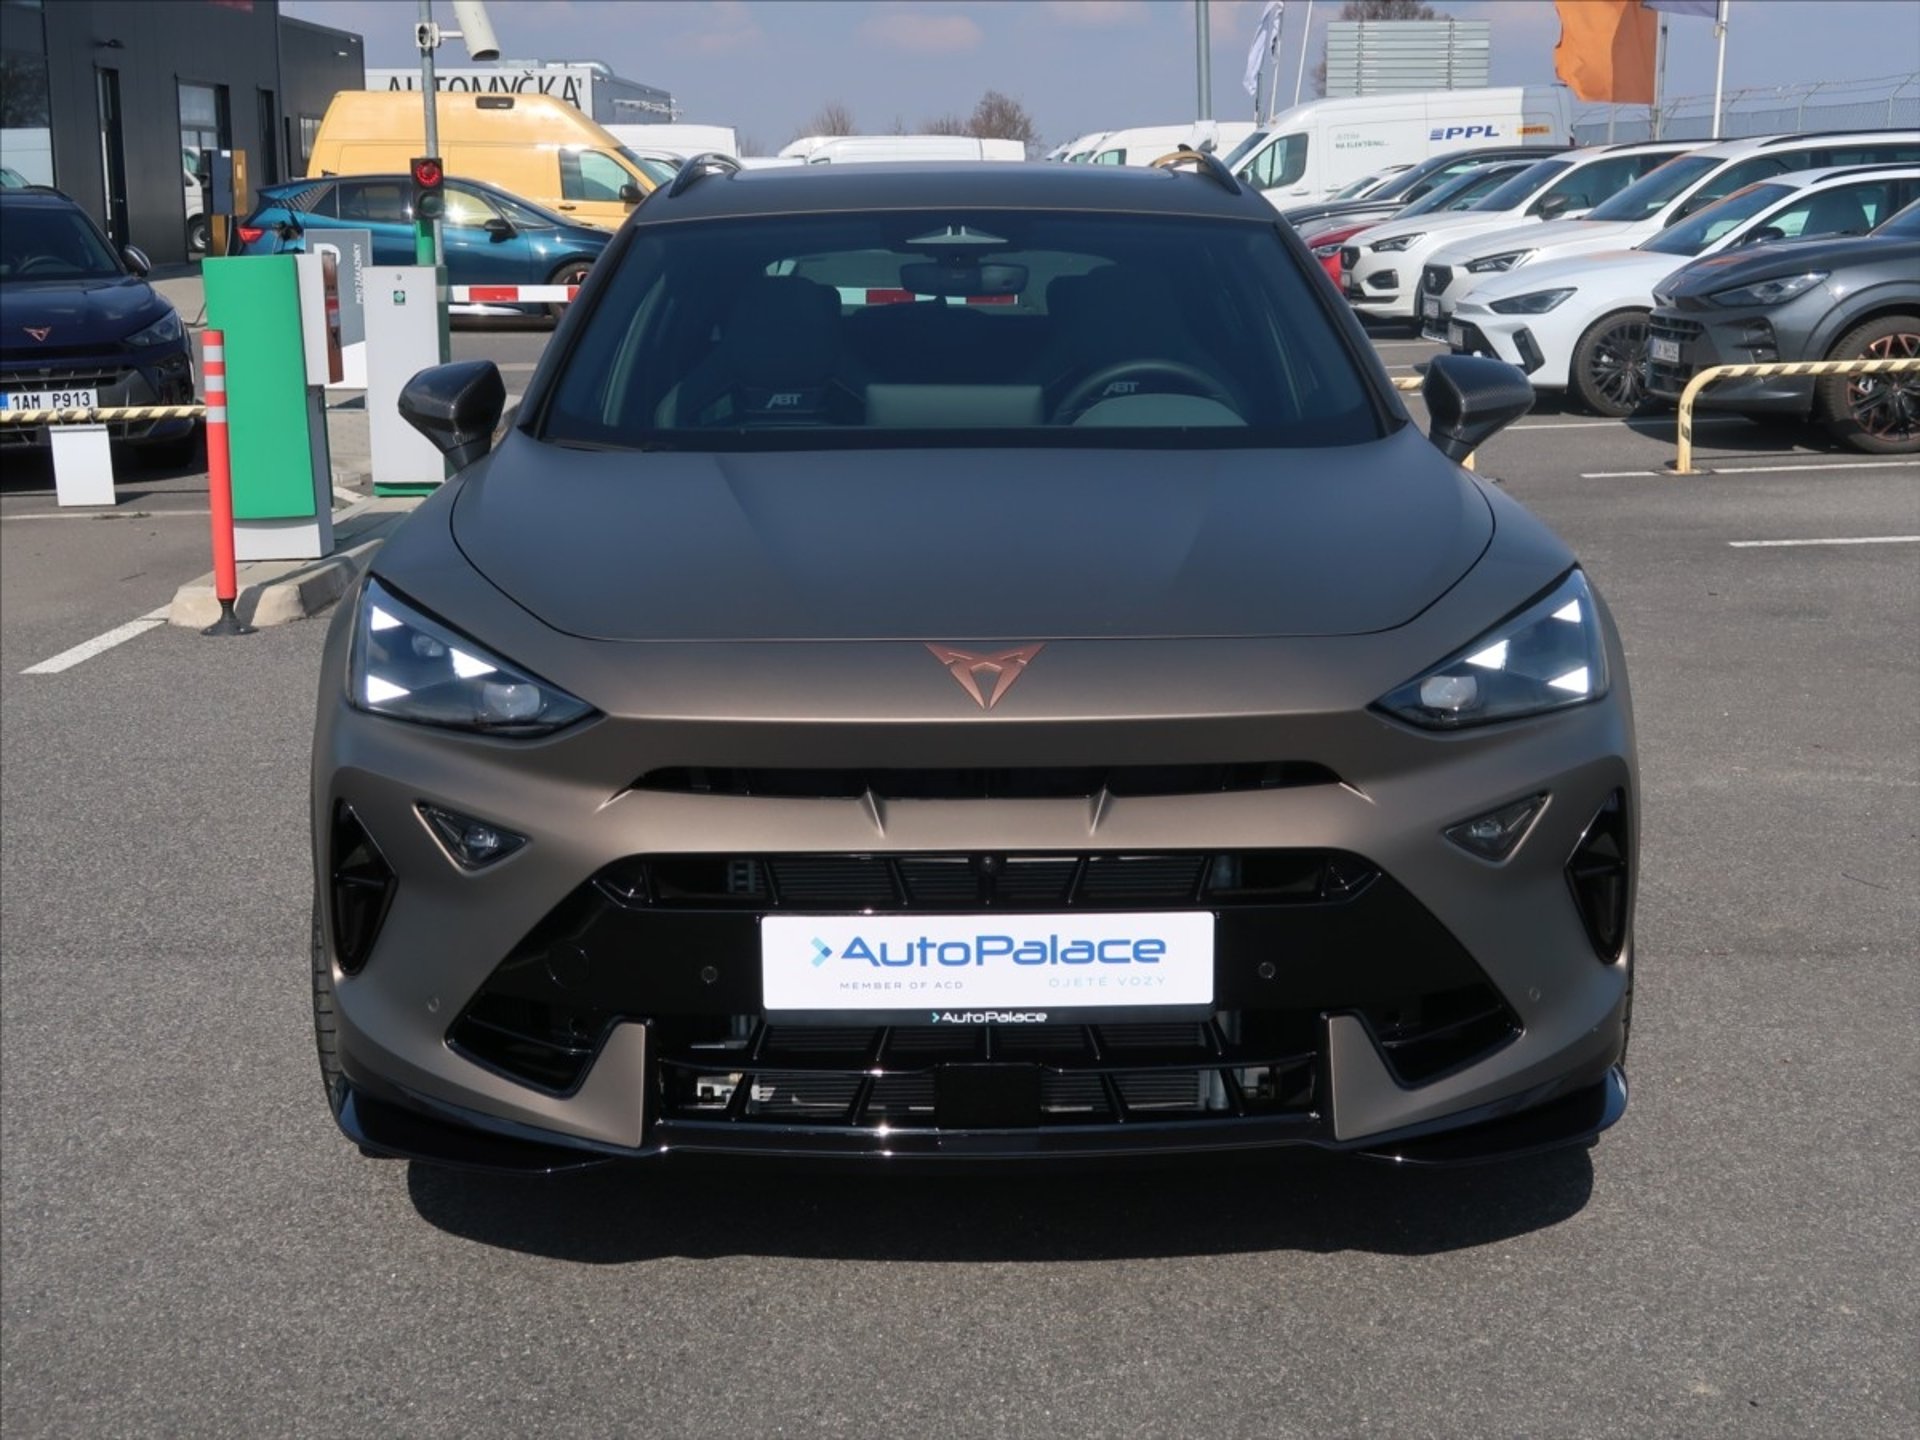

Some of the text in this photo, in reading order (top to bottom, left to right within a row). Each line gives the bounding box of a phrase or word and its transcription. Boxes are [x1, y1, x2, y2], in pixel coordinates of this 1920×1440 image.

[389, 70, 580, 110] ATOMYČKA
[1445, 125, 1500, 140] PPL
[1102, 382, 1140, 396] ABT
[12, 391, 91, 410] 1AM P913
[765, 393, 802, 408] ABT
[840, 933, 1166, 967] AutoPalace
[839, 980, 963, 990] MEMBER OF ACD
[1118, 976, 1166, 987] VOZY
[941, 1011, 1048, 1023] AutoPalace
